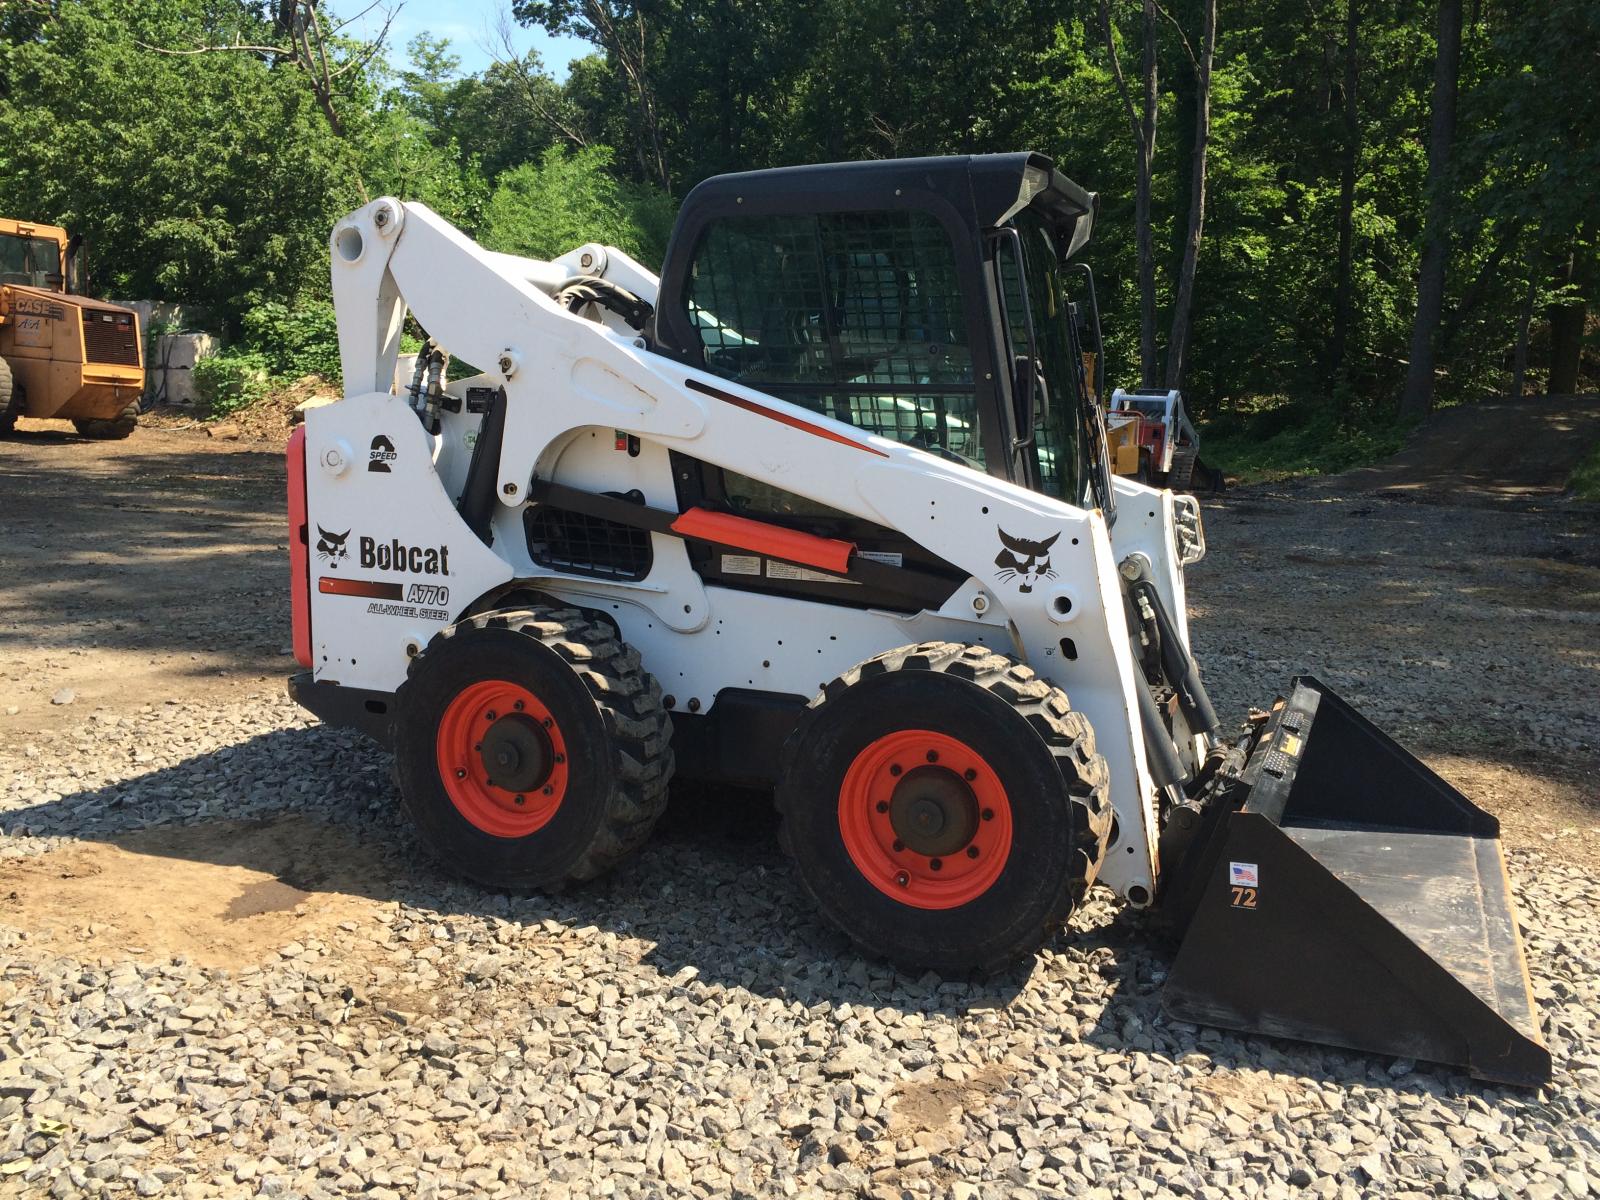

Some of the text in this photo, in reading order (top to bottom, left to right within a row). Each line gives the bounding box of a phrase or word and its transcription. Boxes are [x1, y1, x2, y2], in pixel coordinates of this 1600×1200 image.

[16, 299, 52, 314] CASE
[368, 434, 395, 473] 2
[370, 451, 397, 461] SPEED
[360, 536, 449, 576] Bobcat
[407, 584, 449, 606] A770
[367, 603, 449, 621] ALL-WHEEL STEER
[1231, 886, 1257, 907] 72
